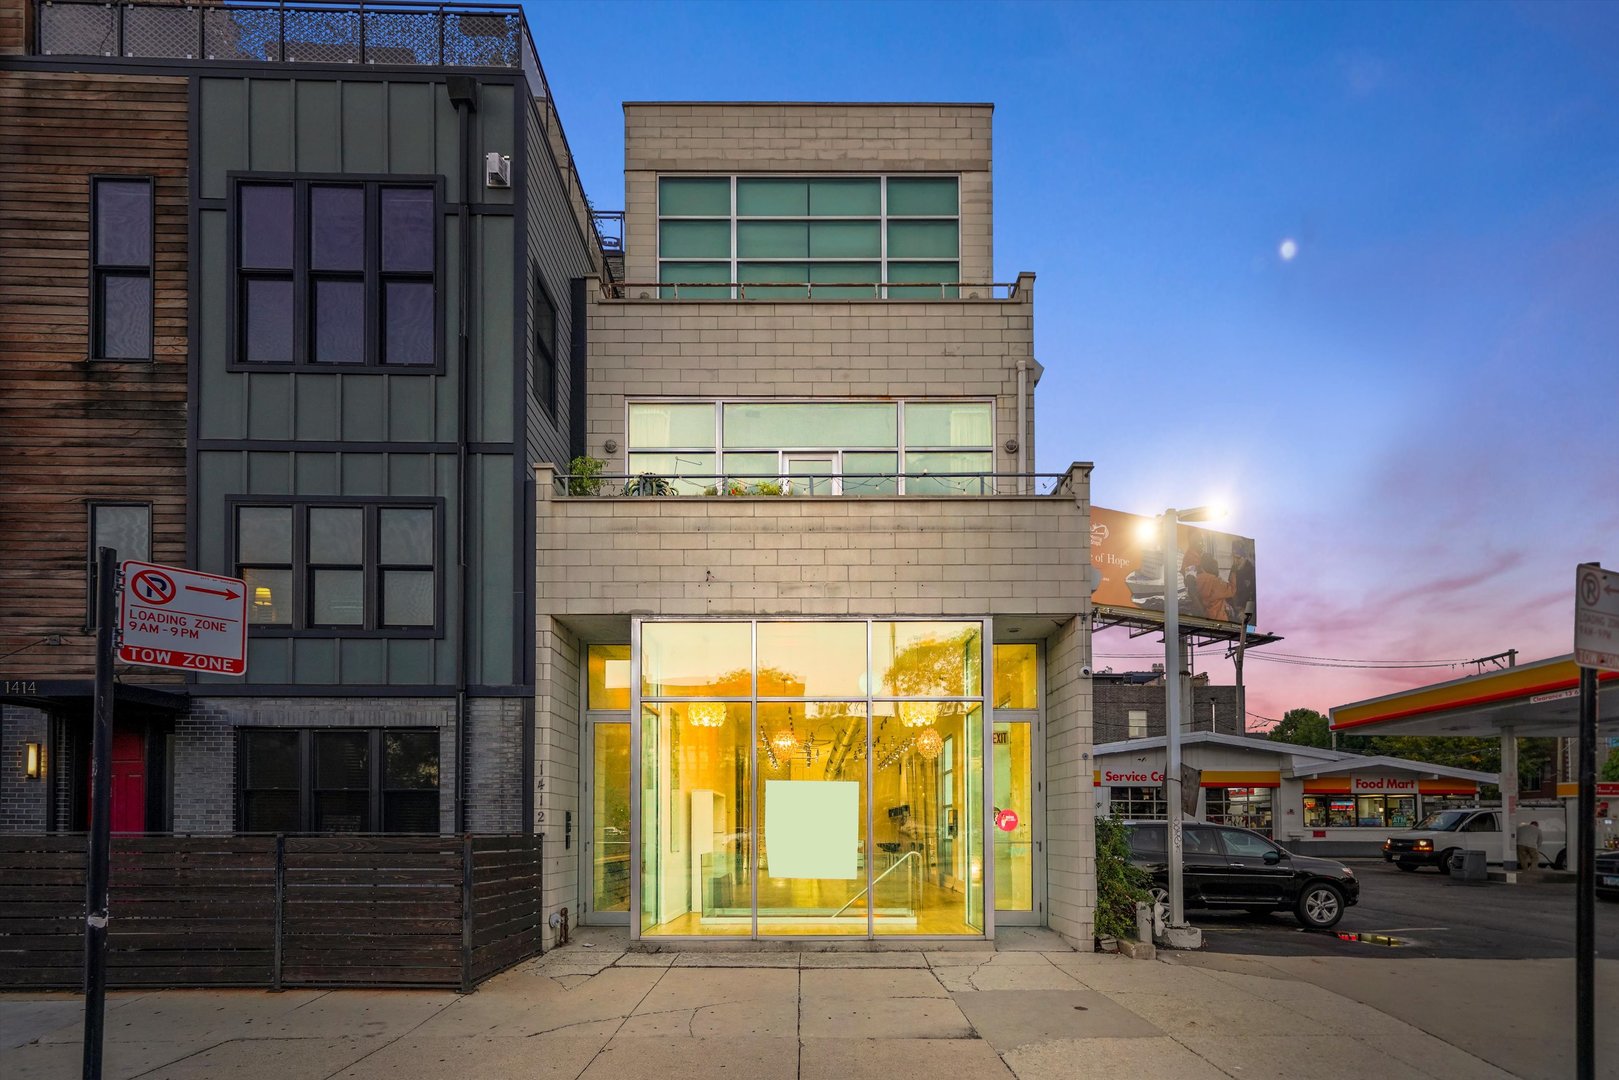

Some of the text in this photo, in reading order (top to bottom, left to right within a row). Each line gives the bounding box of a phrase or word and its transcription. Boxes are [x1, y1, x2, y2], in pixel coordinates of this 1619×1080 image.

[1095, 552, 1130, 568] of Hope
[129, 609, 227, 633] LOADING ZONE
[128, 647, 234, 672] TOW ZONE
[5, 681, 37, 694] 1414
[1532, 693, 1563, 703] Clearance
[992, 732, 1007, 744] EXIT
[1105, 771, 1147, 782] Service
[1355, 778, 1415, 789] Food Mart
[1392, 815, 1407, 824] ATM
